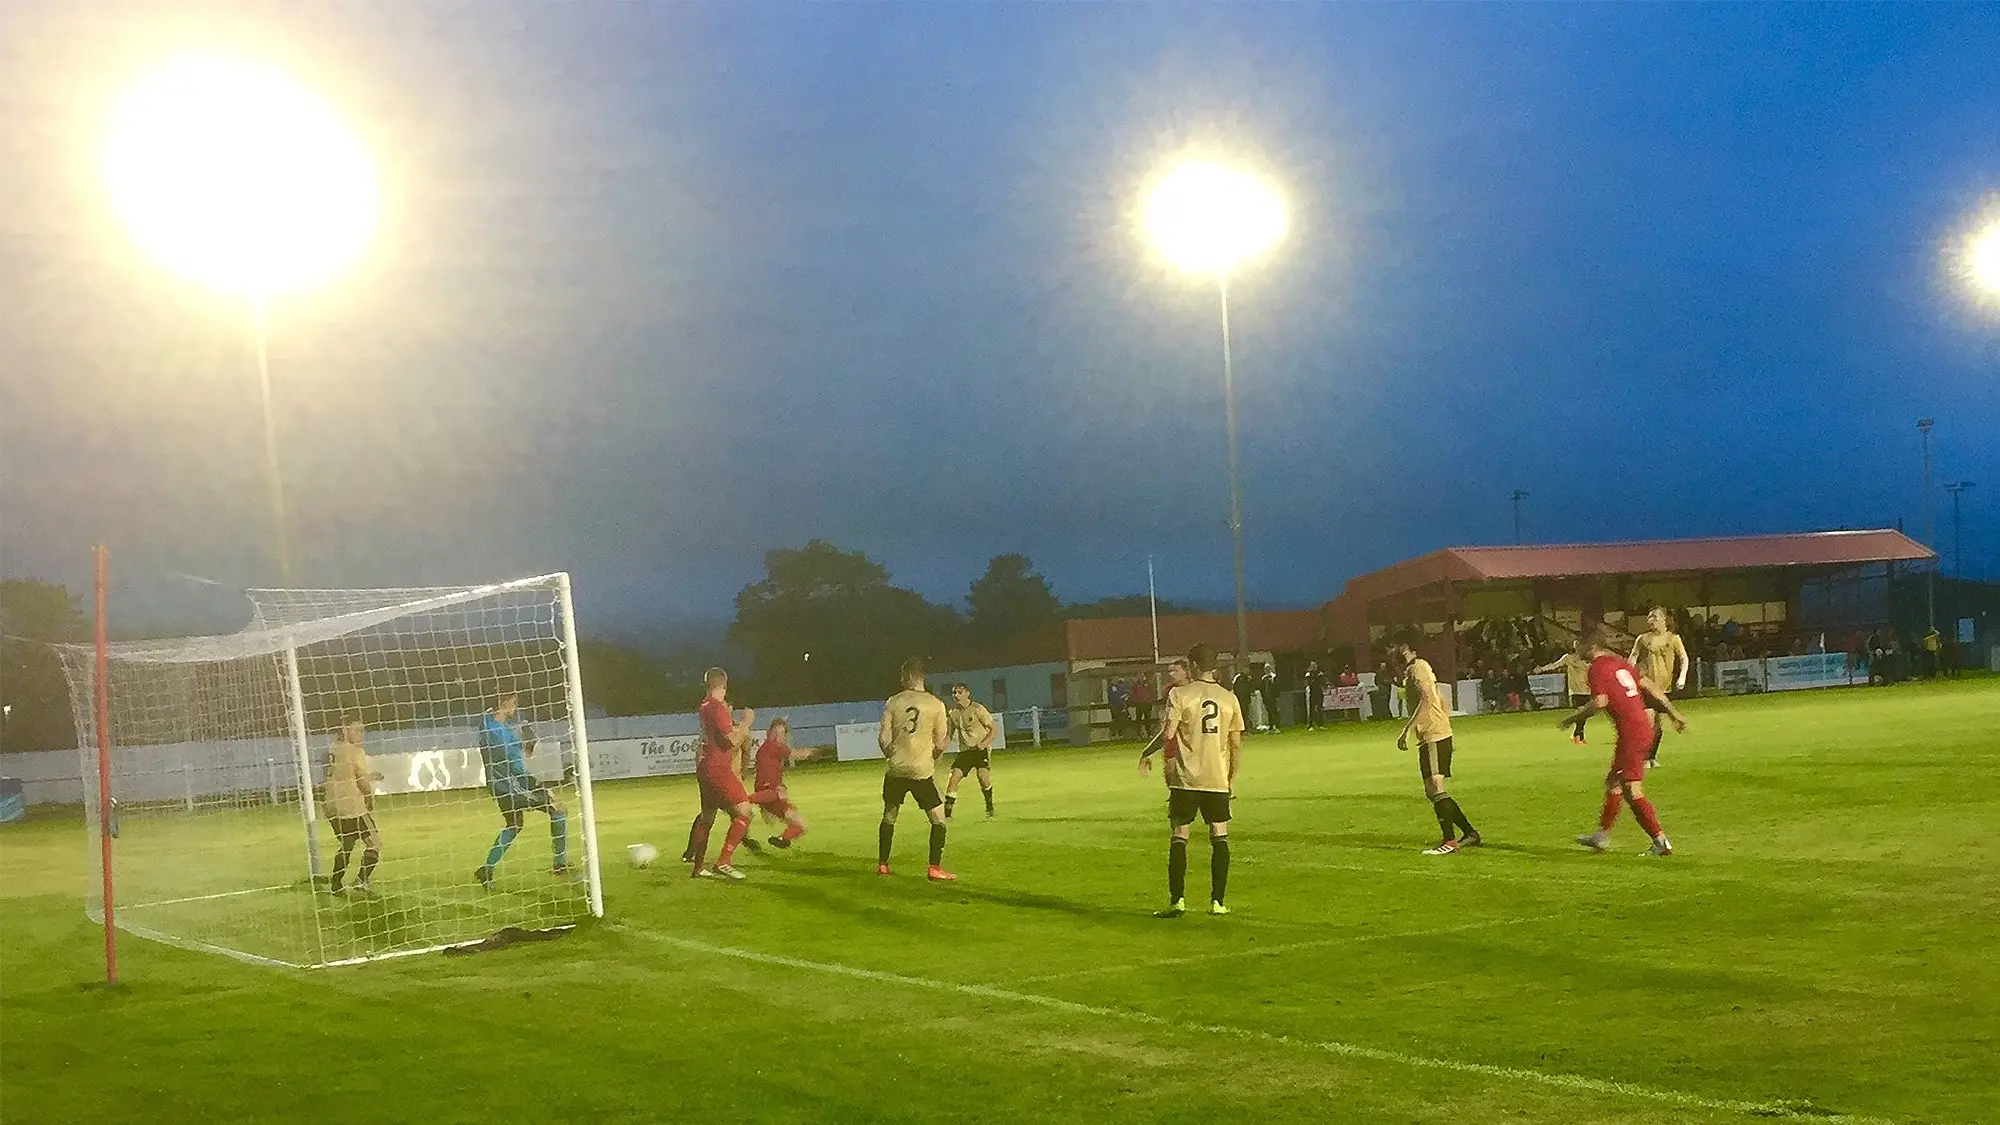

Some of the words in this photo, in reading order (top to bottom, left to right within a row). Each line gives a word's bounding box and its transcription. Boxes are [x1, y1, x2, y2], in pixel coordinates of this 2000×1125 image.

[903, 706, 920, 733] 3
[1201, 699, 1219, 734] 2
[641, 741, 664, 755] The
[670, 739, 698, 756] Gol
